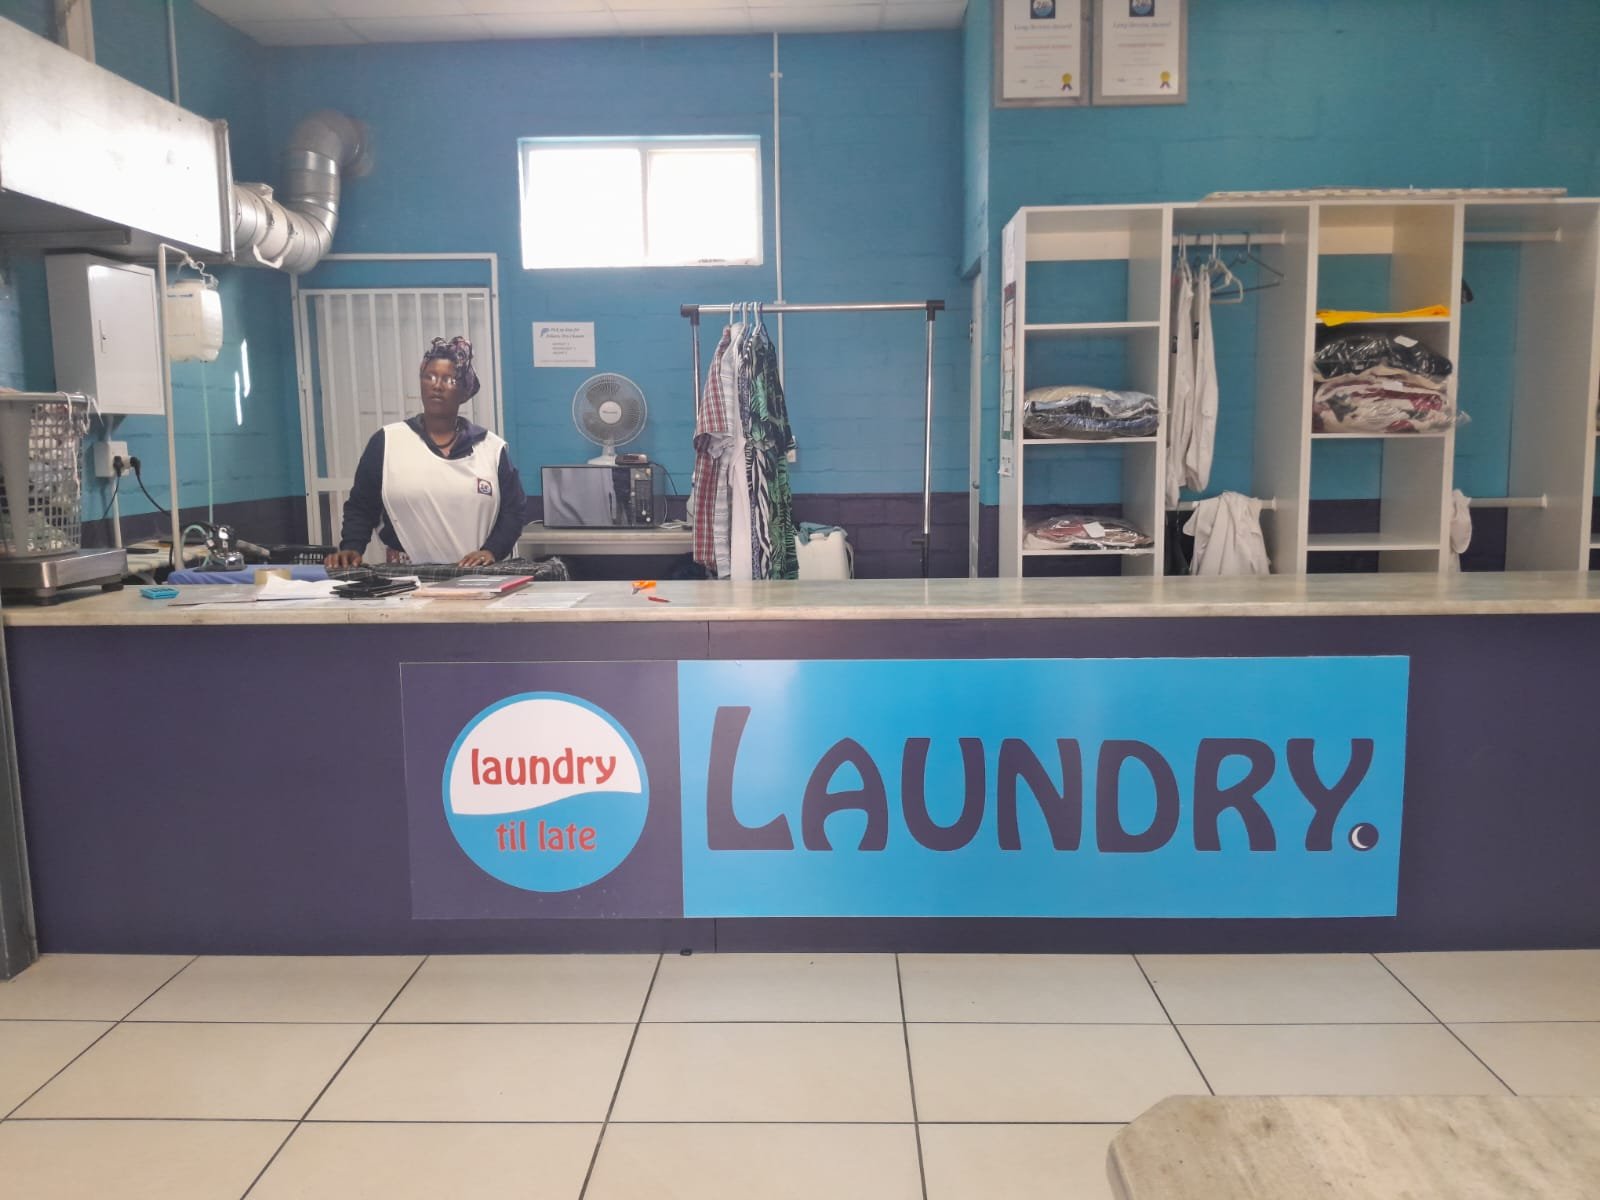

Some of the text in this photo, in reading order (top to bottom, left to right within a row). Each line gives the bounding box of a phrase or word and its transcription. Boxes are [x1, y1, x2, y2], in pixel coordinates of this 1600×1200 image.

[471, 748, 616, 785] laundry
[496, 821, 596, 851] til late
